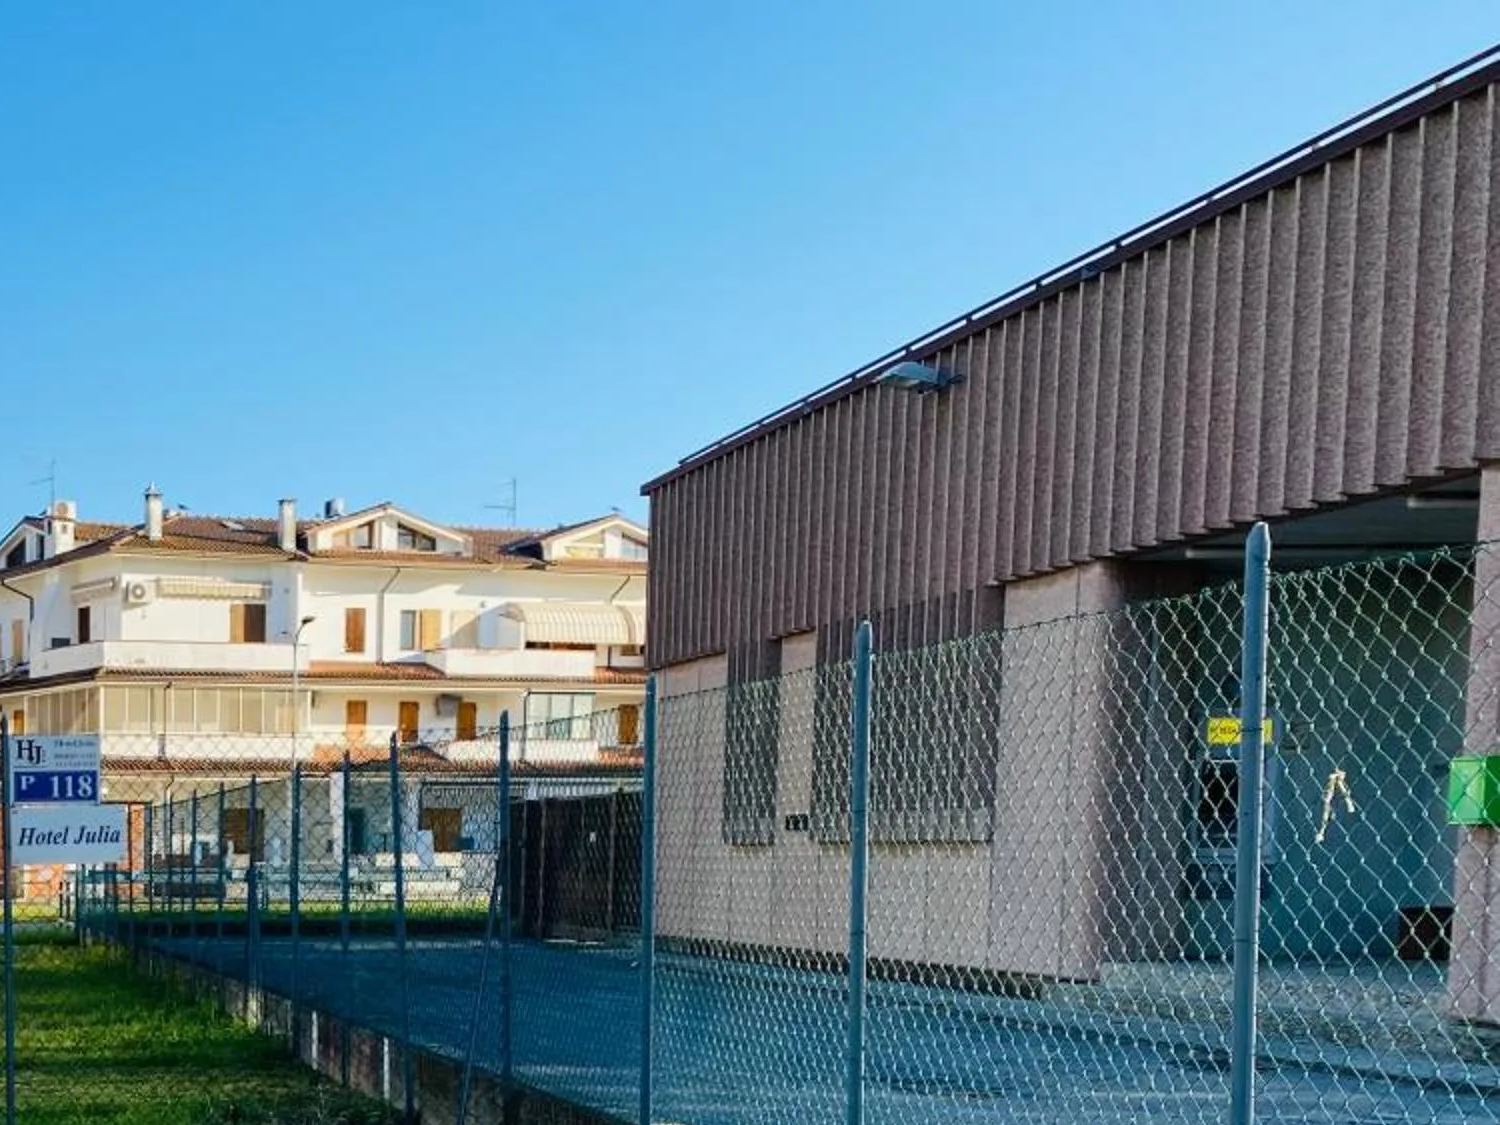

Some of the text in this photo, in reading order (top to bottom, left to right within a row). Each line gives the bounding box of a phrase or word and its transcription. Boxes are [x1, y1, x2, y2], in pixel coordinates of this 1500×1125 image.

[20, 774, 93, 799] P 118
[18, 824, 122, 847] Hotel Julia
